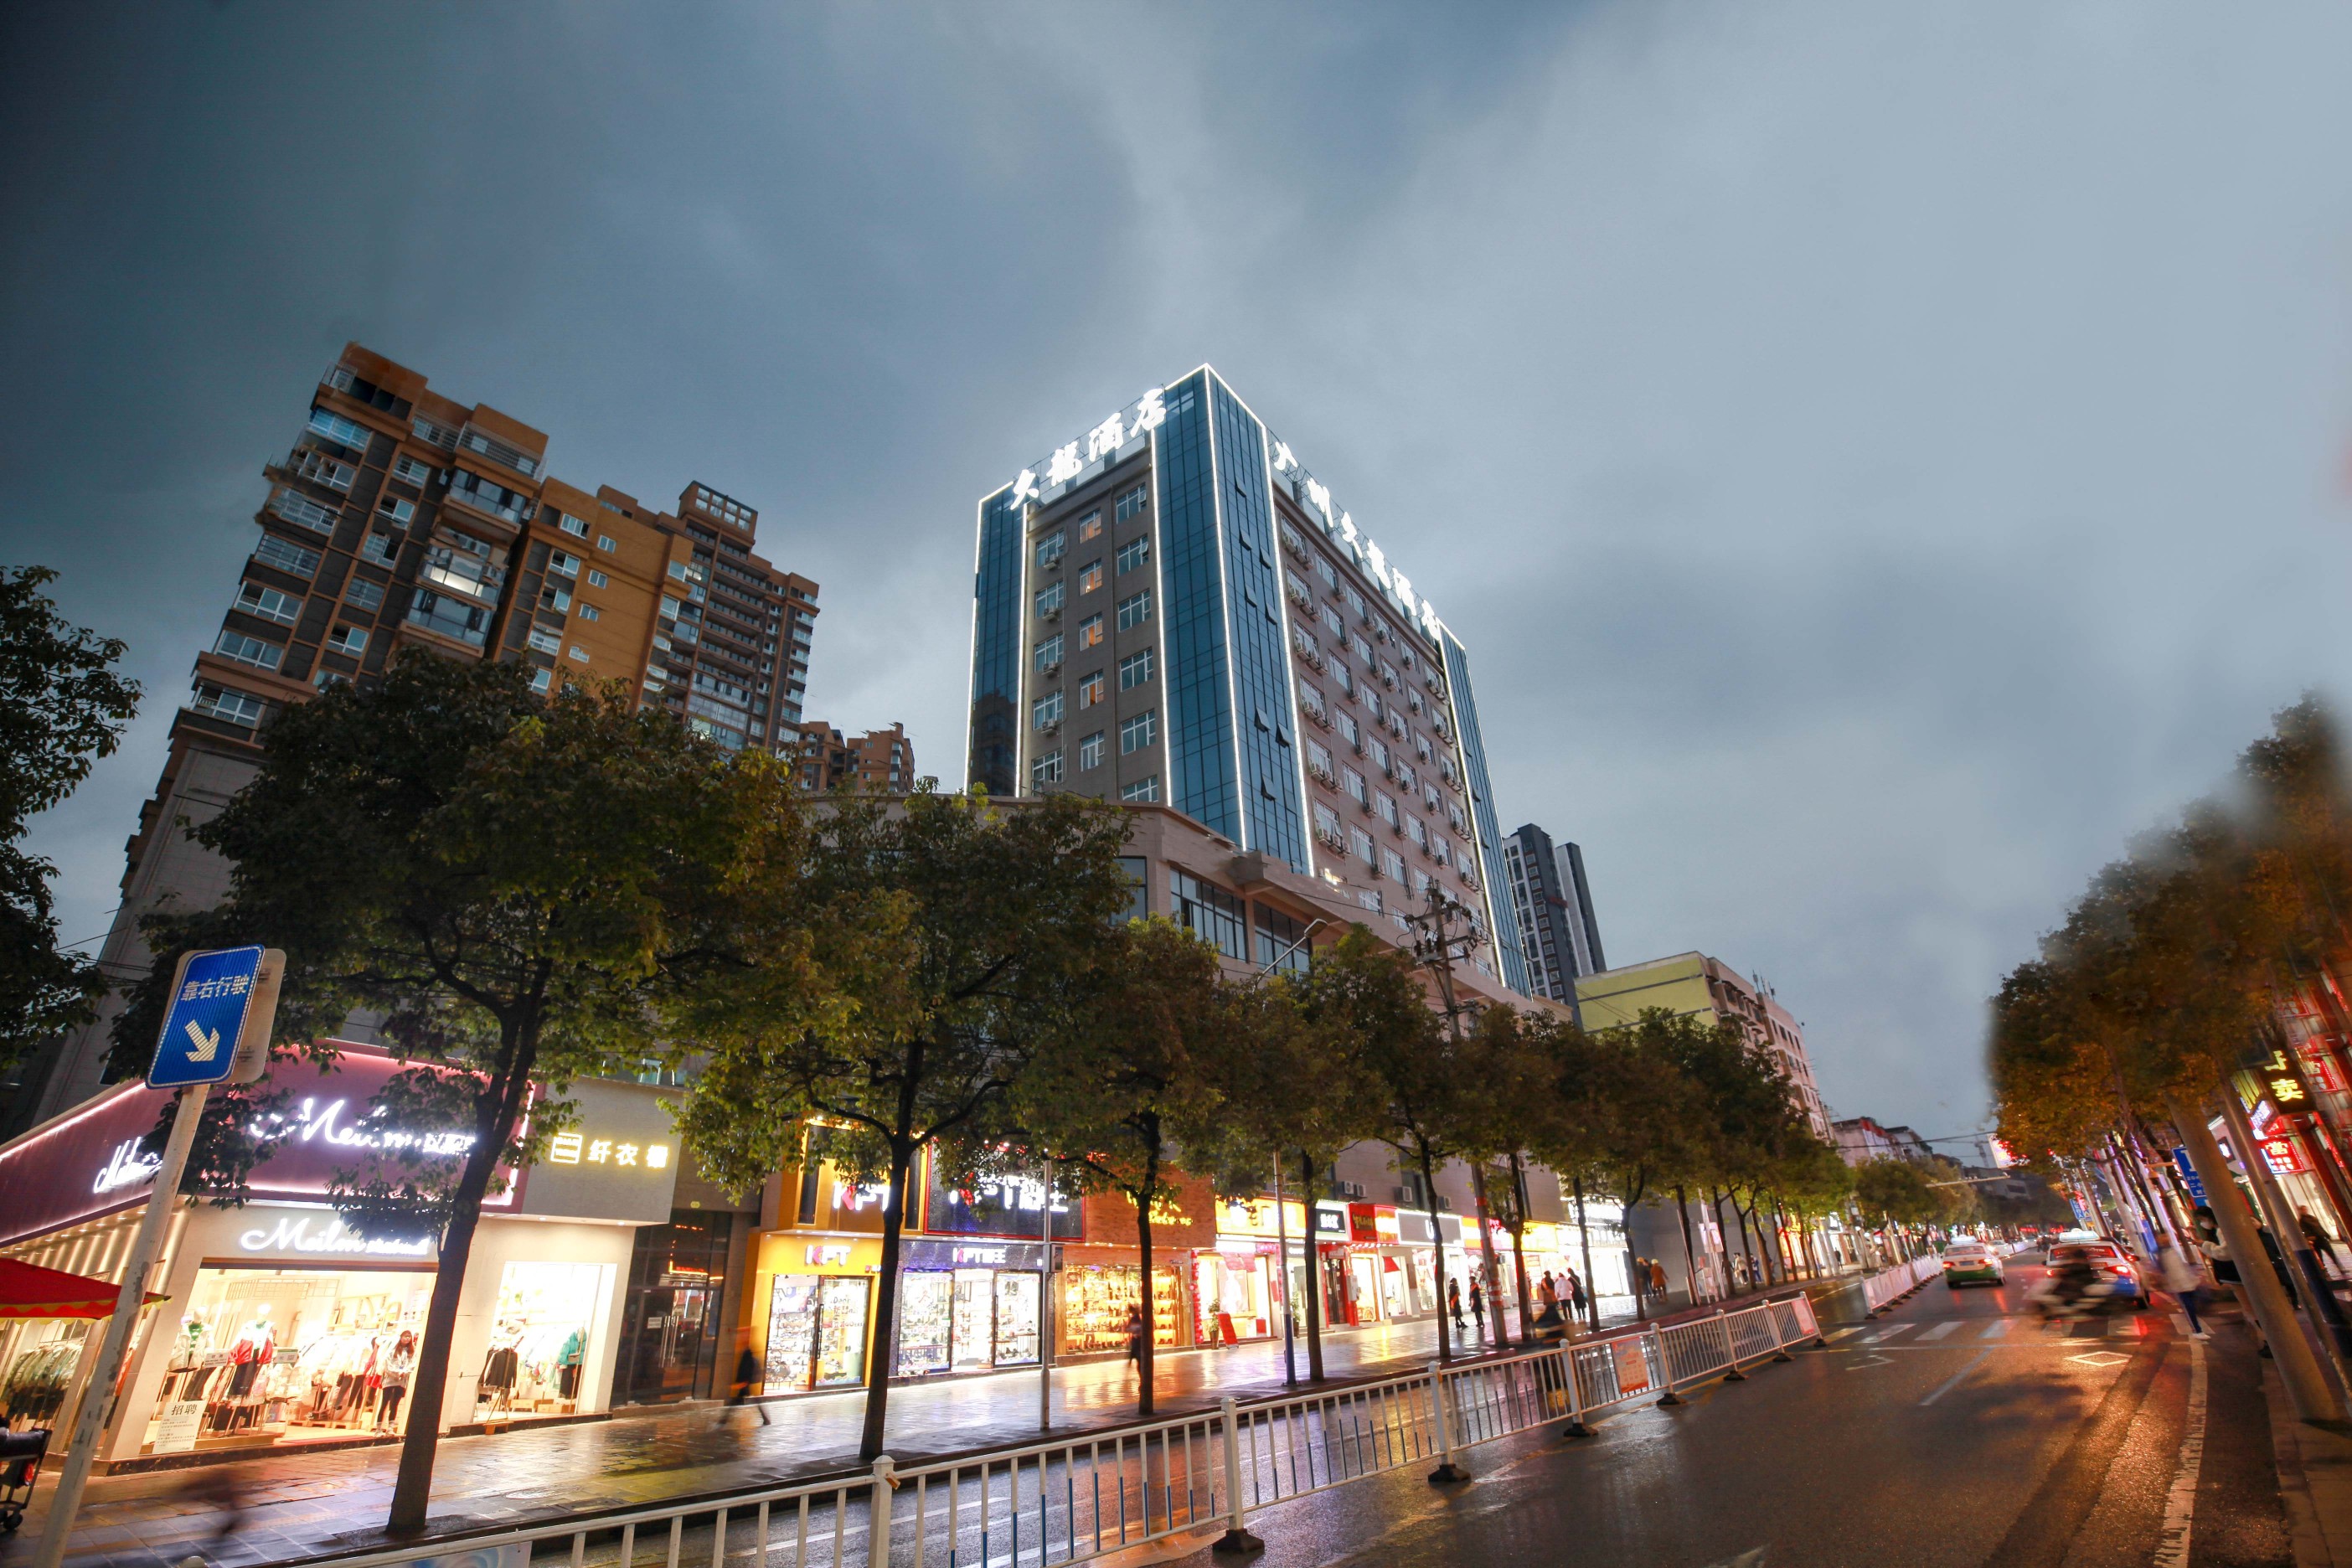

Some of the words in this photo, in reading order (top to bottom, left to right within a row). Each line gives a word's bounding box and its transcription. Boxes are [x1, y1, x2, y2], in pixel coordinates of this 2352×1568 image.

[180, 973, 250, 1002] 靠右行驶
[806, 1244, 852, 1266] KPT
[171, 1404, 198, 1416] 招聘
